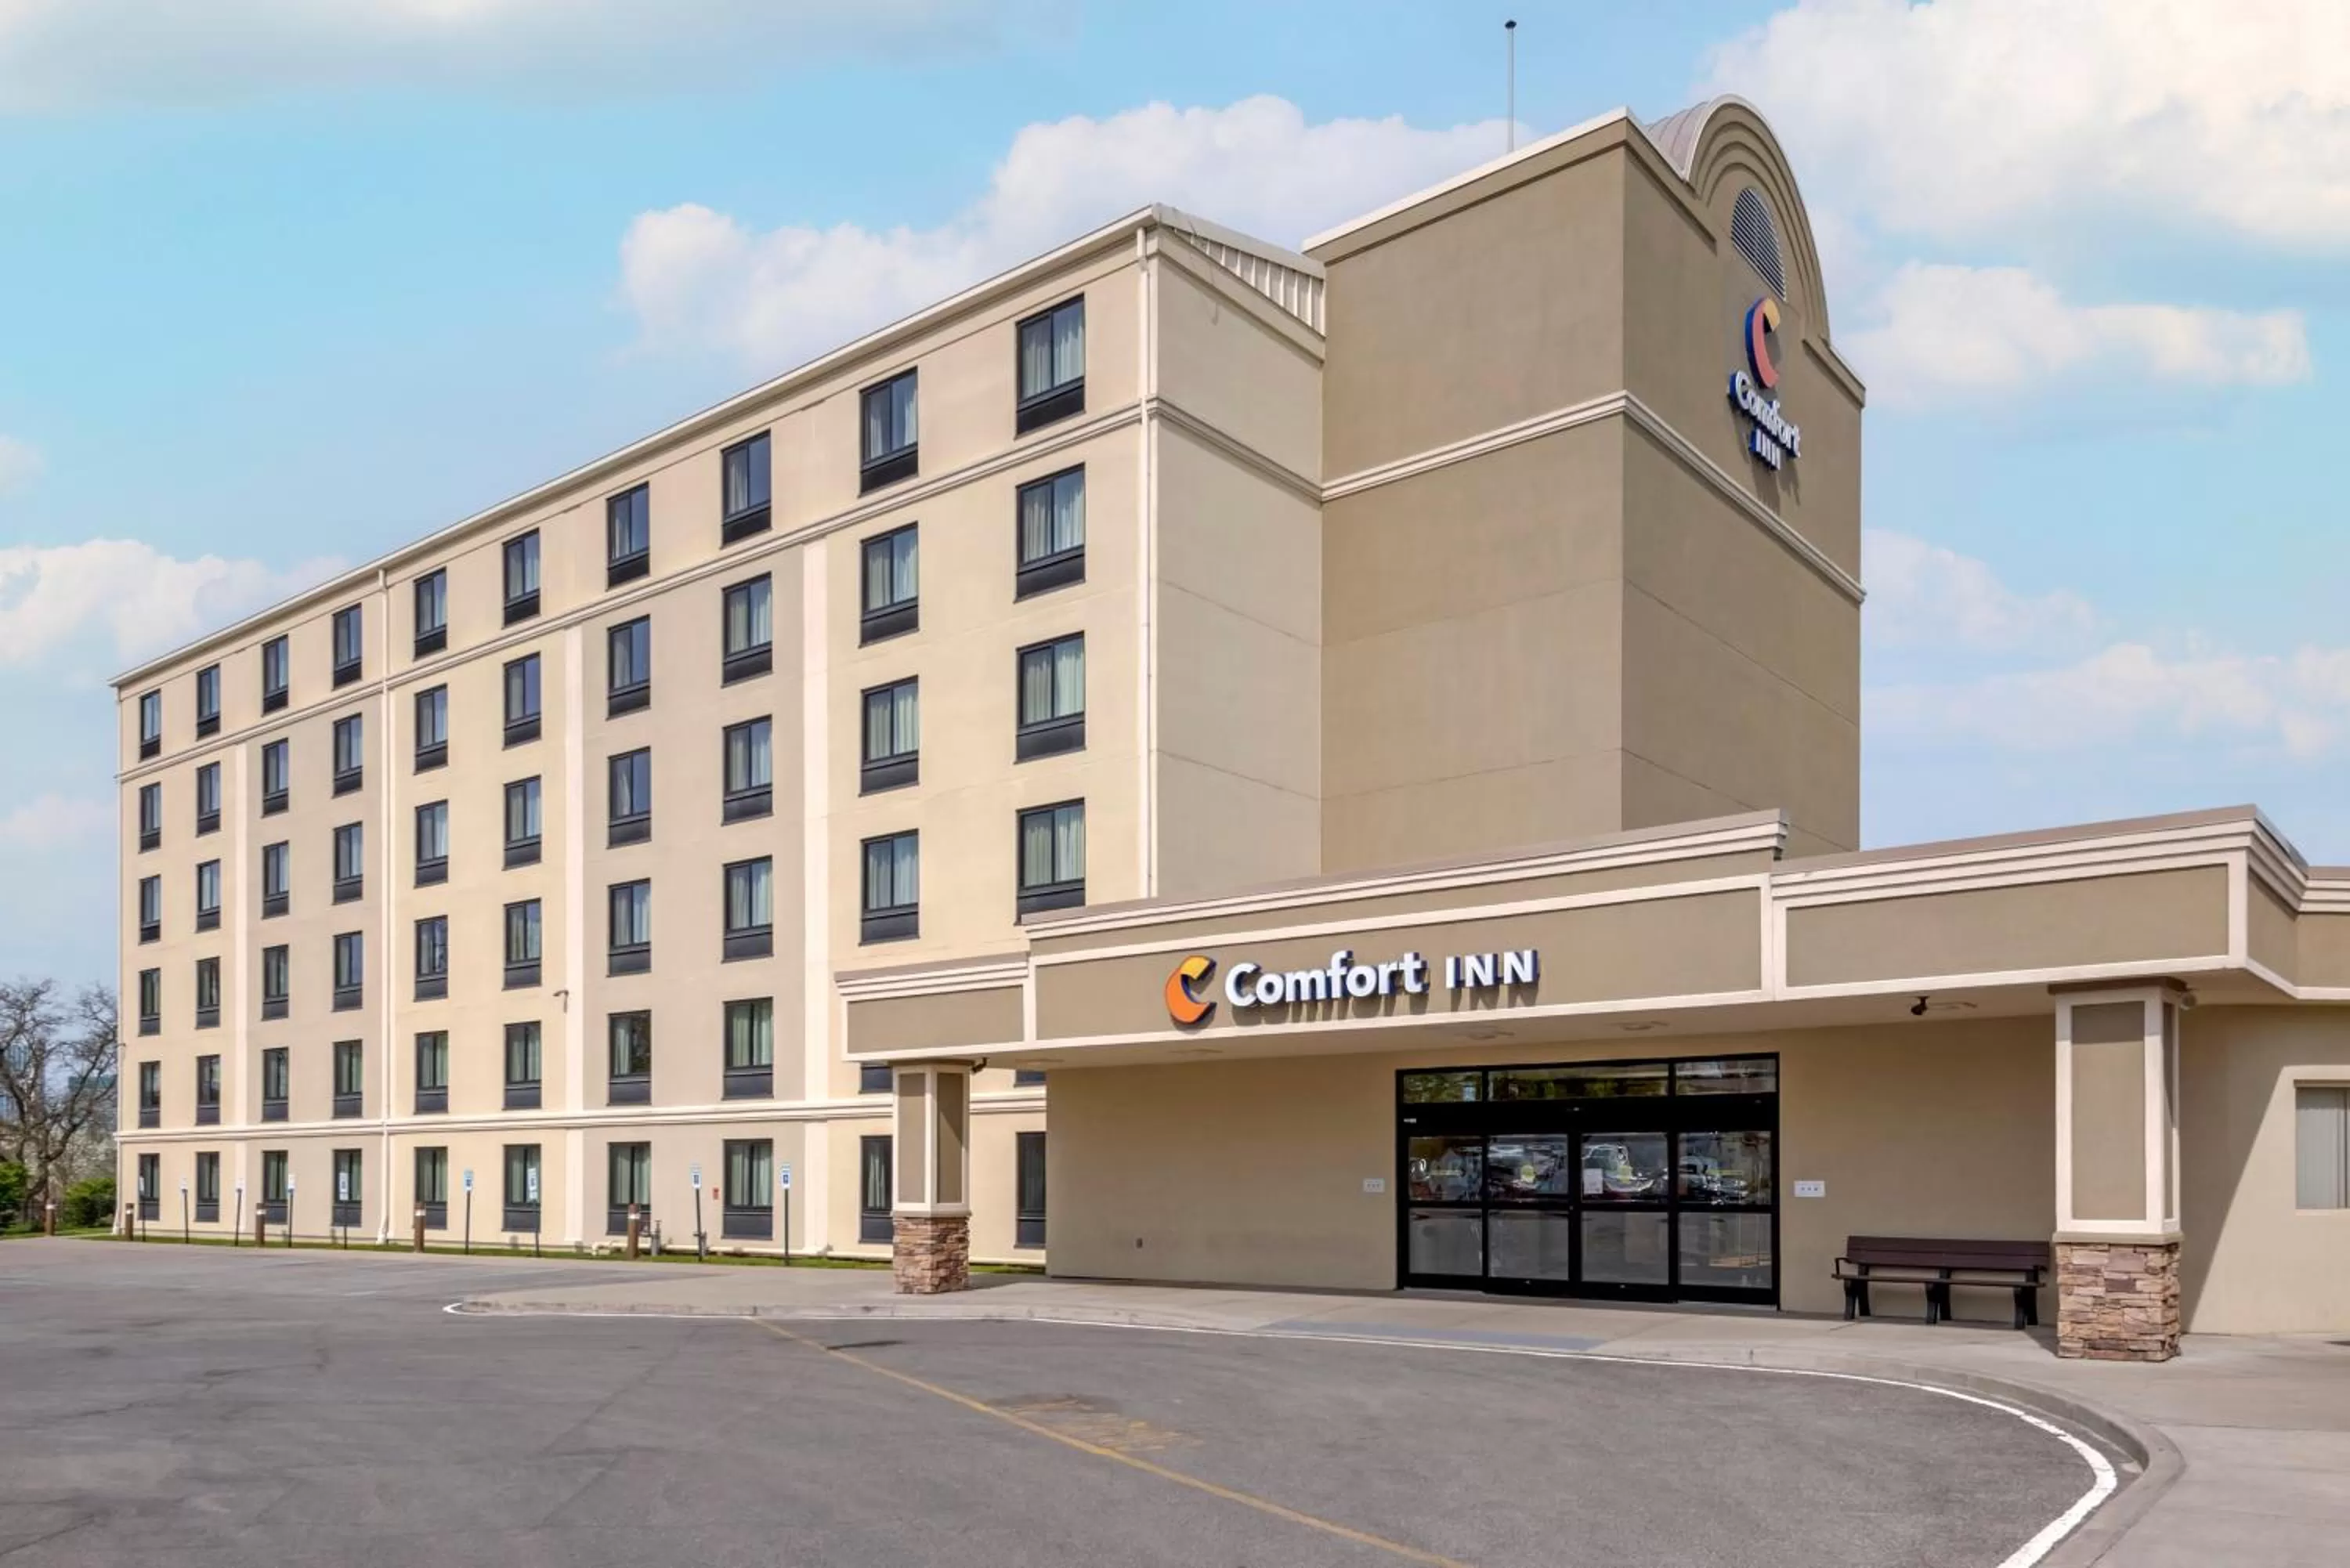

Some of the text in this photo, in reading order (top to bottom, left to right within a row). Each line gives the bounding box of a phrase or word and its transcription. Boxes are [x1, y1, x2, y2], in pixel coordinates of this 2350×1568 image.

[1730, 369, 1800, 458] Comfort
[1224, 949, 1538, 1007] Comfort INN
